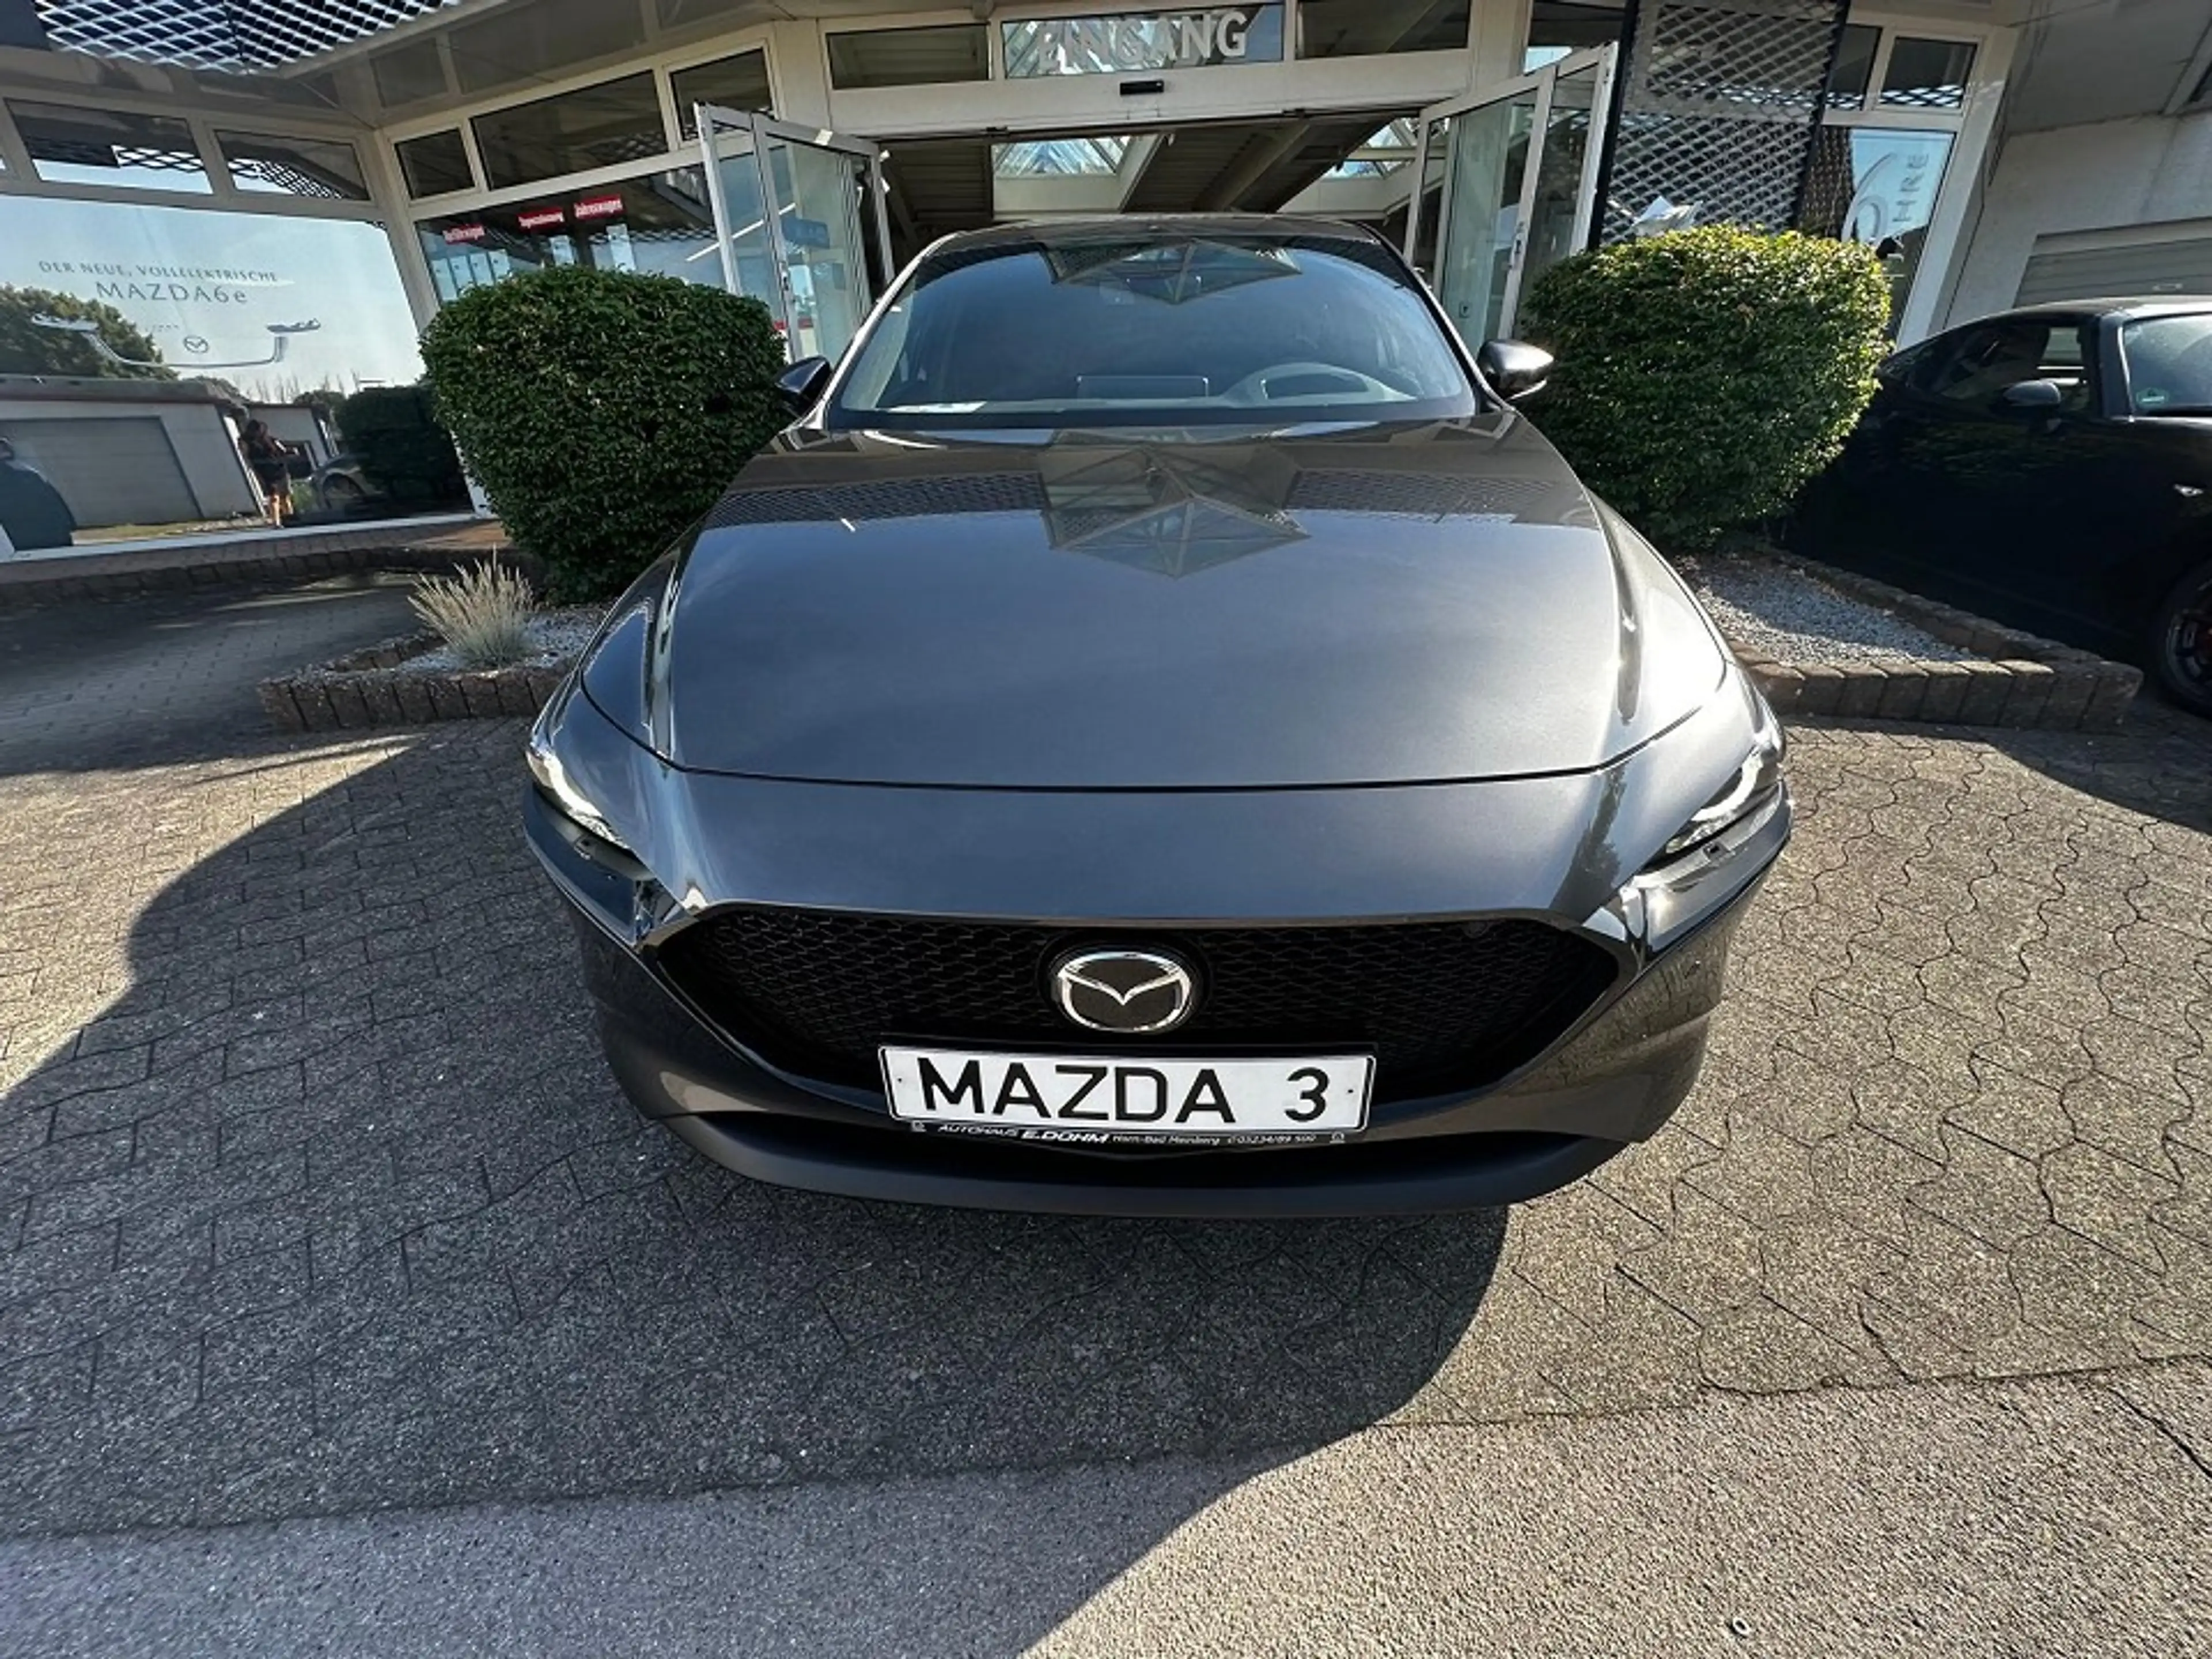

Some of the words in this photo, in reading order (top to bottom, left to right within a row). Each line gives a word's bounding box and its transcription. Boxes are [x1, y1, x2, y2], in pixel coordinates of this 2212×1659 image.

[1038, 12, 1248, 70] EINGANG
[39, 260, 75, 273] DER
[79, 263, 132, 277] NEUE,
[135, 264, 277, 282] VOLLELEKTRISCHE
[96, 281, 247, 303] MAZDA6e
[918, 1057, 1236, 1123] MAZDA
[1285, 1067, 1330, 1122] 3
[937, 1124, 1018, 1137] AUTOHAUS
